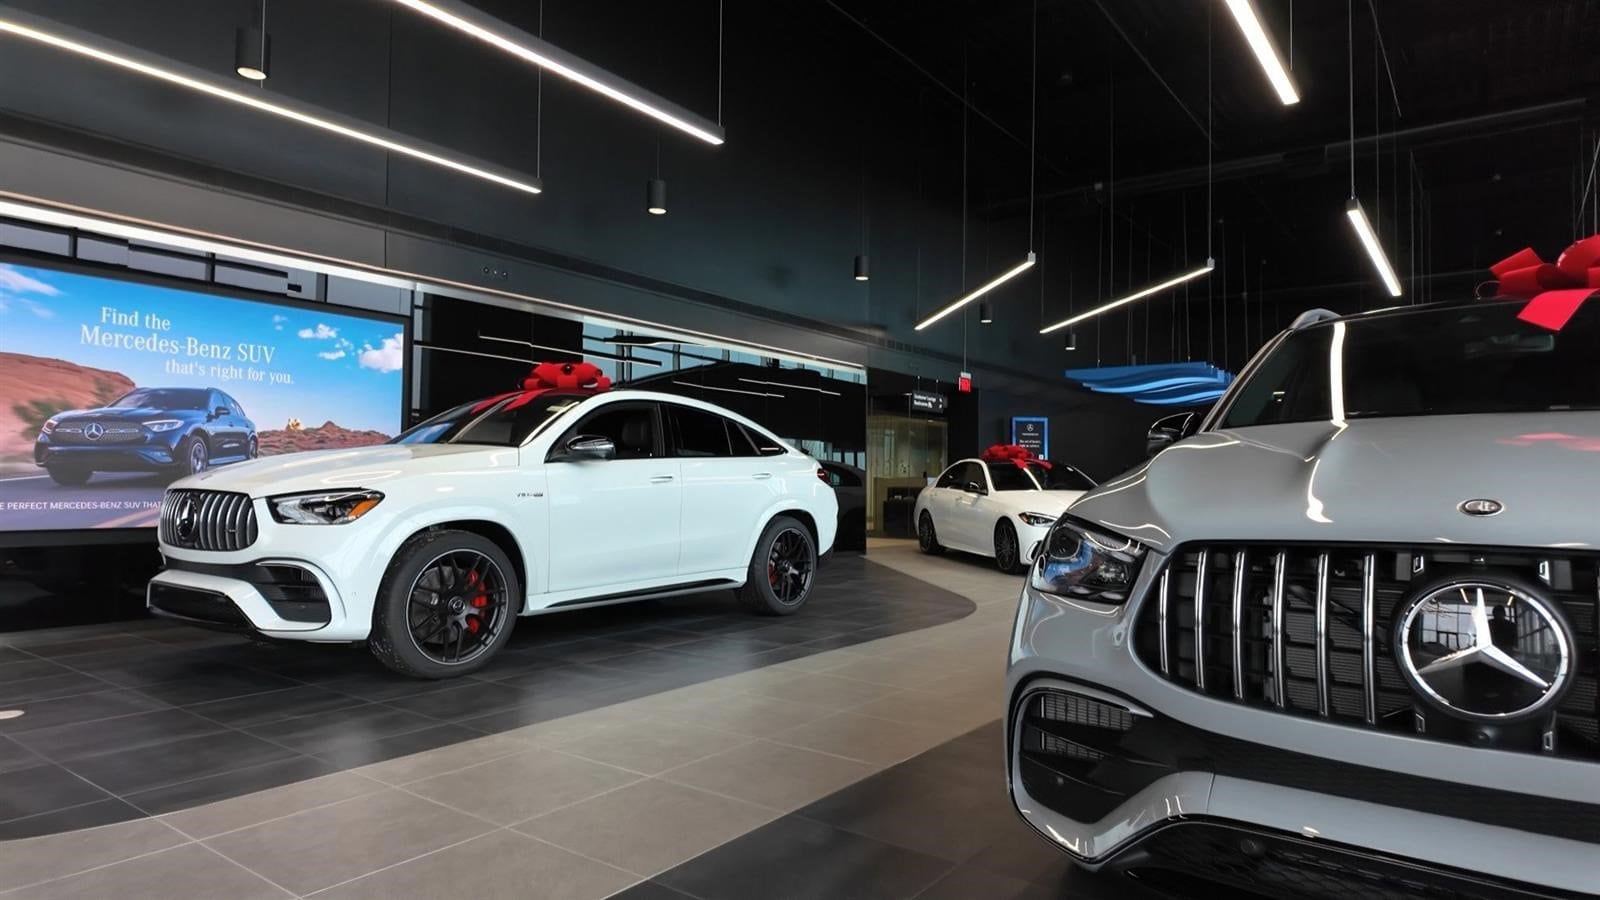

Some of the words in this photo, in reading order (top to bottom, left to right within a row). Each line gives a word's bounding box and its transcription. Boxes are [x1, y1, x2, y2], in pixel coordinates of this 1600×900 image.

[101, 306, 139, 327] Find
[144, 312, 172, 331] the
[80, 324, 231, 360] Mercedes-Benz
[237, 342, 276, 364] SUV
[165, 359, 206, 377] that's
[210, 364, 243, 382] right
[247, 367, 266, 382] for
[269, 371, 294, 385] you.
[7, 501, 48, 510] PERFECT
[50, 501, 122, 510] MERCEDES-BENZ
[123, 501, 141, 509] SUV
